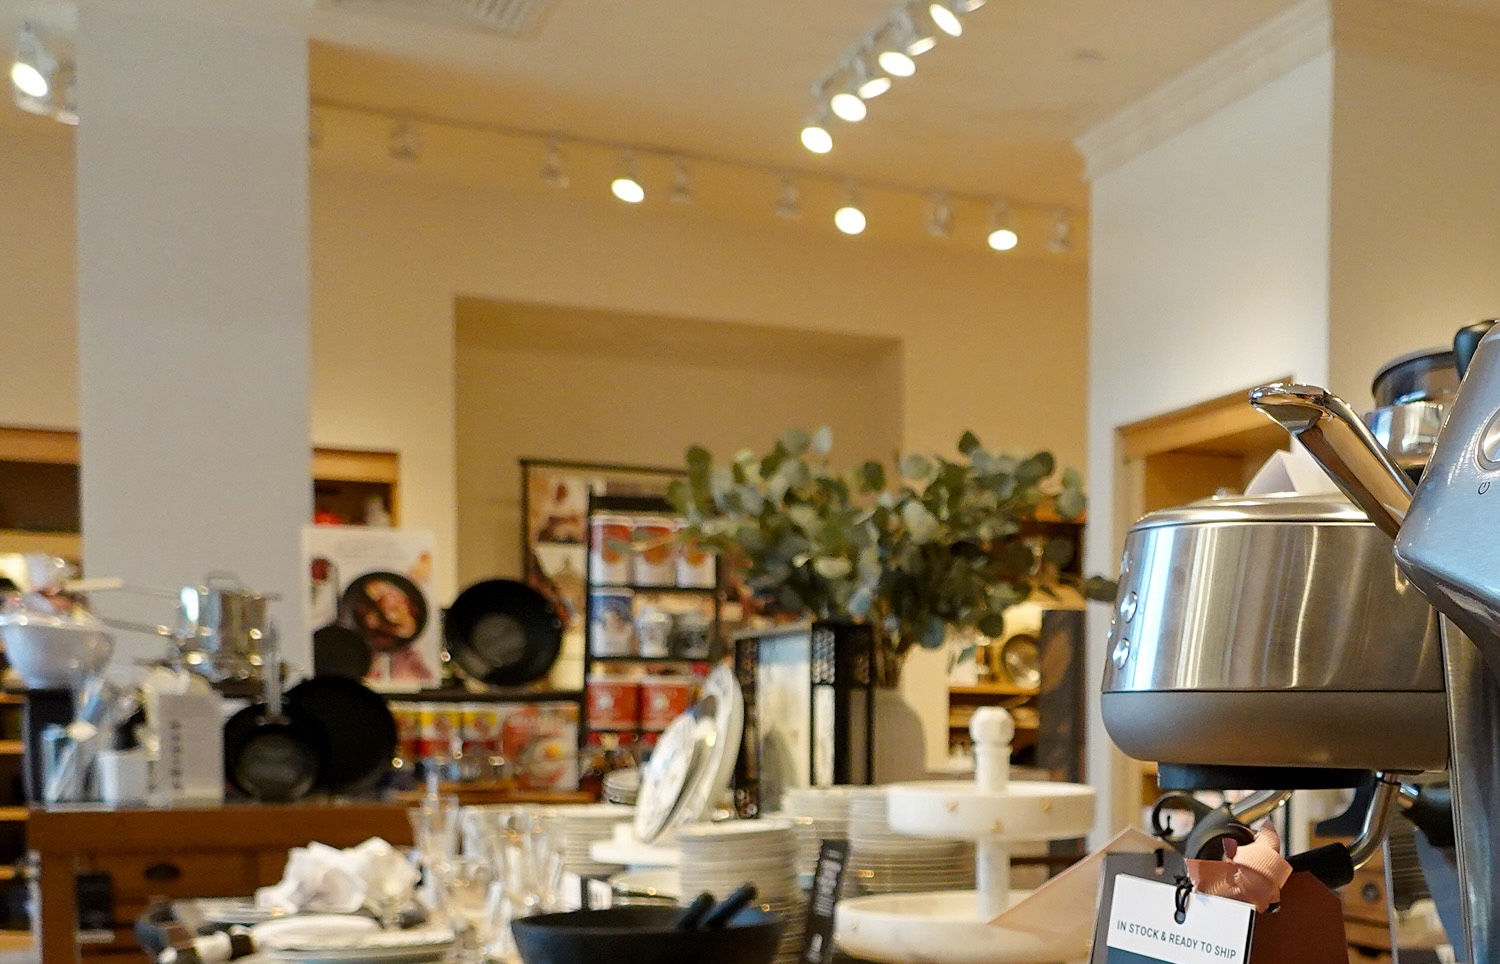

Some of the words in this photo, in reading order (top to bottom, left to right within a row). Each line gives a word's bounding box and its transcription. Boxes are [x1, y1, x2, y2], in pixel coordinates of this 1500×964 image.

[1117, 920, 1126, 931] IN
[1129, 923, 1159, 940] STOCK
[1160, 931, 1166, 941] &
[1169, 933, 1198, 949] READY
[1201, 941, 1212, 953] TO
[1214, 945, 1236, 959] SHIP
